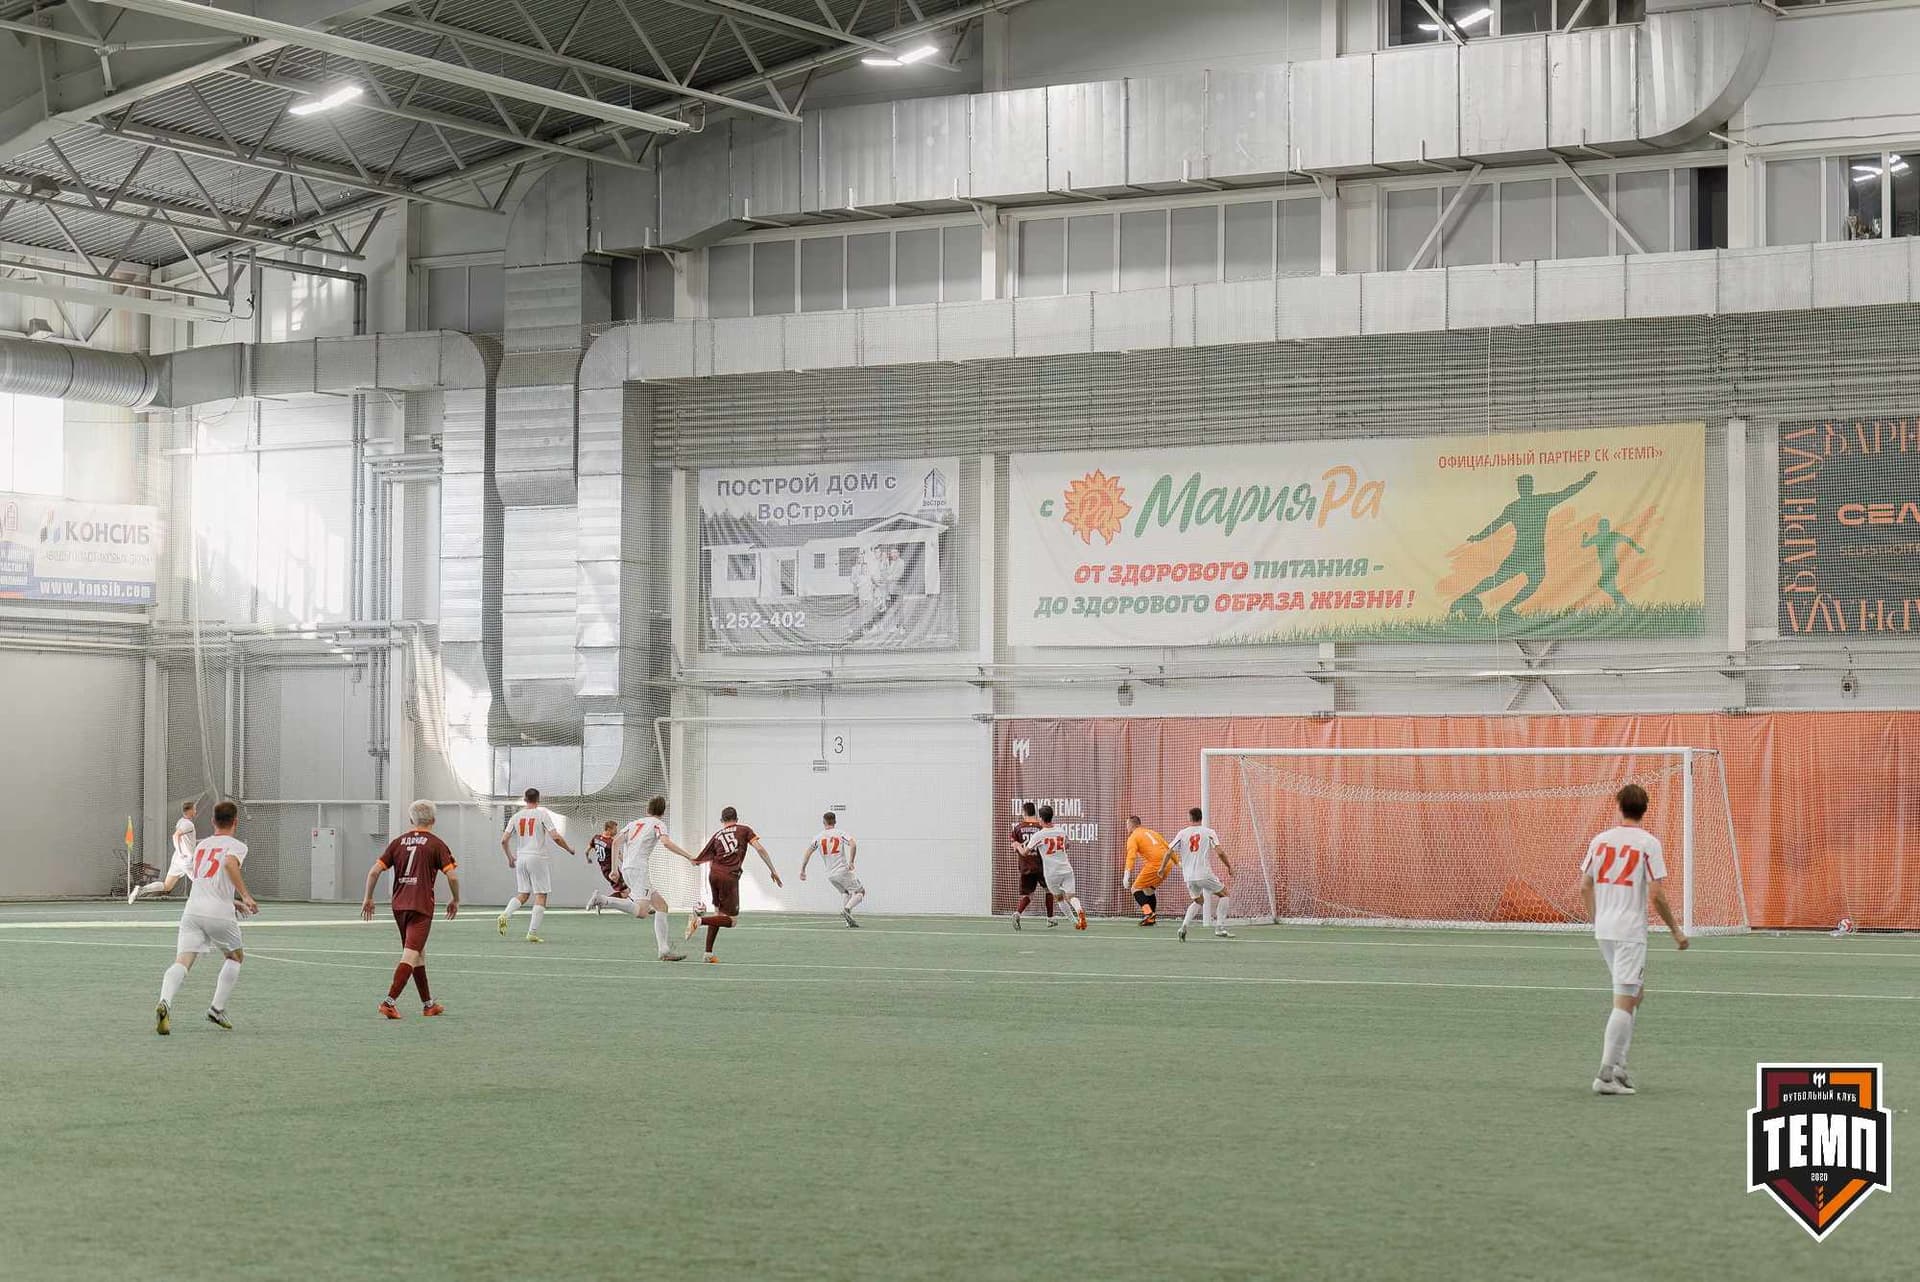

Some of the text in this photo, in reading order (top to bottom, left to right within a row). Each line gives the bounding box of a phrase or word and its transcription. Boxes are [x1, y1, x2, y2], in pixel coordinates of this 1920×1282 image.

[1438, 445, 1663, 471] ОФИЦИАЛЬНЫЙ ПАРТНЕР СК «ТЕМП»
[717, 472, 819, 497] ПОСТРОЙ
[827, 472, 878, 495] ДОМ
[758, 500, 854, 520] ВоСтрой
[1040, 499, 1054, 517] с
[65, 520, 150, 544] КОНСИБ
[1074, 564, 1106, 584] ОТ
[1110, 561, 1249, 586] ЗДОРОВОГО
[1253, 558, 1369, 580] ПИТАНИЯ
[40, 580, 150, 598] www.konsib.com
[1033, 589, 1416, 618] ДО ЗДОРОВОГО ОБРАЗА ЖИЗНИ!
[834, 736, 844, 754] 3
[1054, 799, 1084, 818] ТЕМП,
[518, 818, 536, 837] 11
[630, 823, 645, 841] 7
[821, 837, 840, 855] 12
[1189, 832, 1201, 852] 8
[194, 848, 223, 879] 15
[406, 846, 417, 876] 7
[1596, 843, 1640, 887] 22
